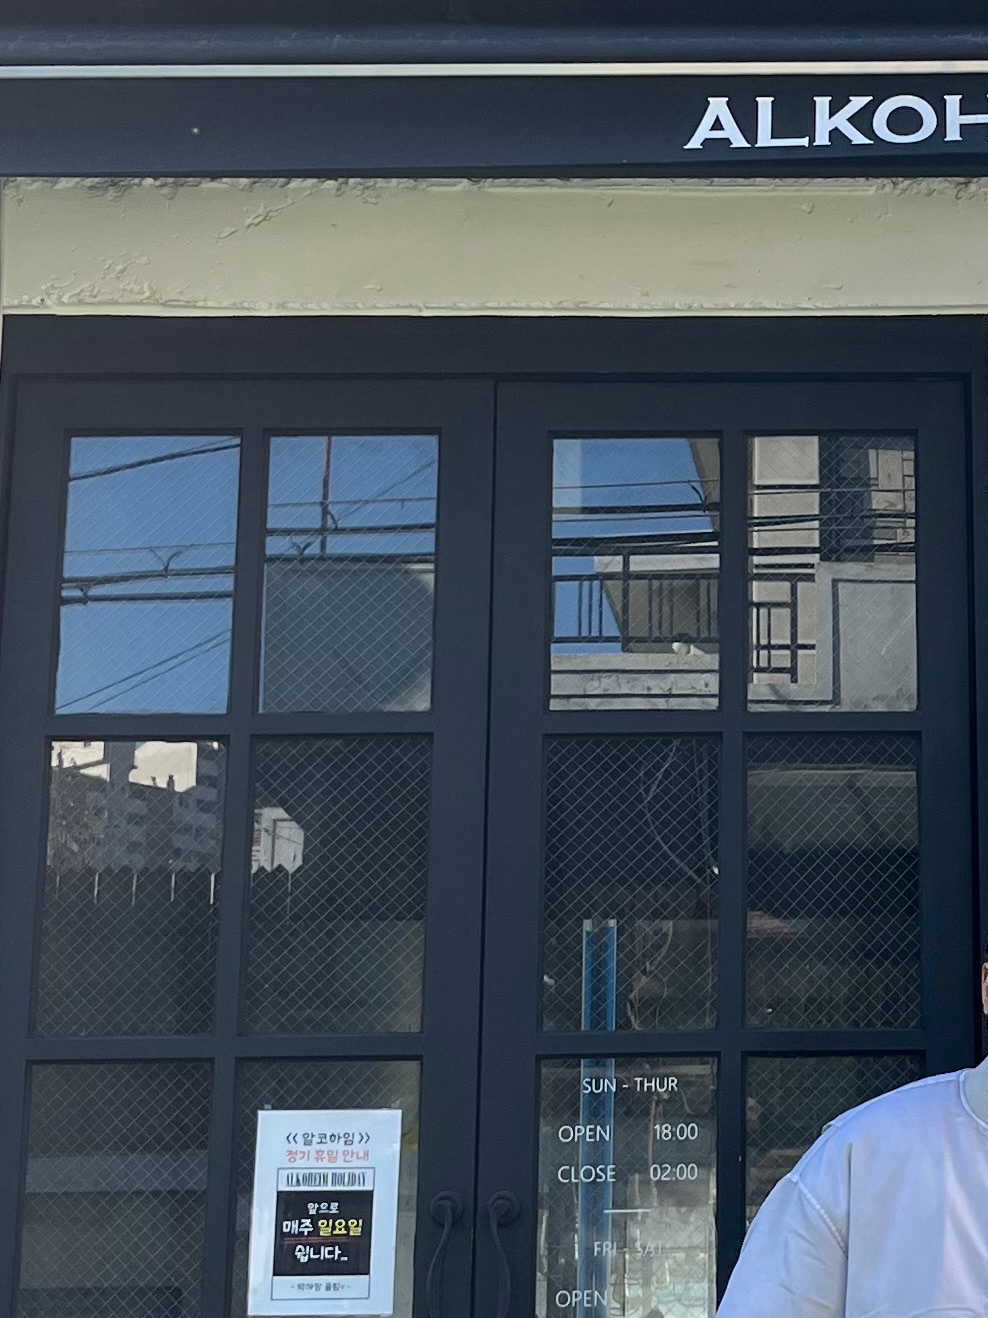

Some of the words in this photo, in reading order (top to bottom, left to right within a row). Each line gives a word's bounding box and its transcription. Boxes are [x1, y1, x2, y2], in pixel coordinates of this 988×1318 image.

[582, 1077, 616, 1093] SUN
[634, 1076, 678, 1092] THUR
[302, 1132, 355, 1146] 알코하임
[558, 1125, 610, 1142] OPEN
[653, 1123, 698, 1141] 18:00
[286, 1150, 310, 1163] 정기
[314, 1149, 338, 1163] 휴일
[343, 1149, 369, 1163] 안내
[286, 1172, 328, 1187] ALKOHEIM
[331, 1172, 367, 1187] HOLIDAY
[557, 1165, 616, 1183] CLOSE
[649, 1163, 698, 1181] 02:00
[307, 1202, 339, 1215] 앞으로
[283, 1219, 313, 1236] 매주
[318, 1219, 363, 1236] 일요일
[593, 1241, 616, 1257] FRI
[555, 1290, 607, 1308] OPEN
